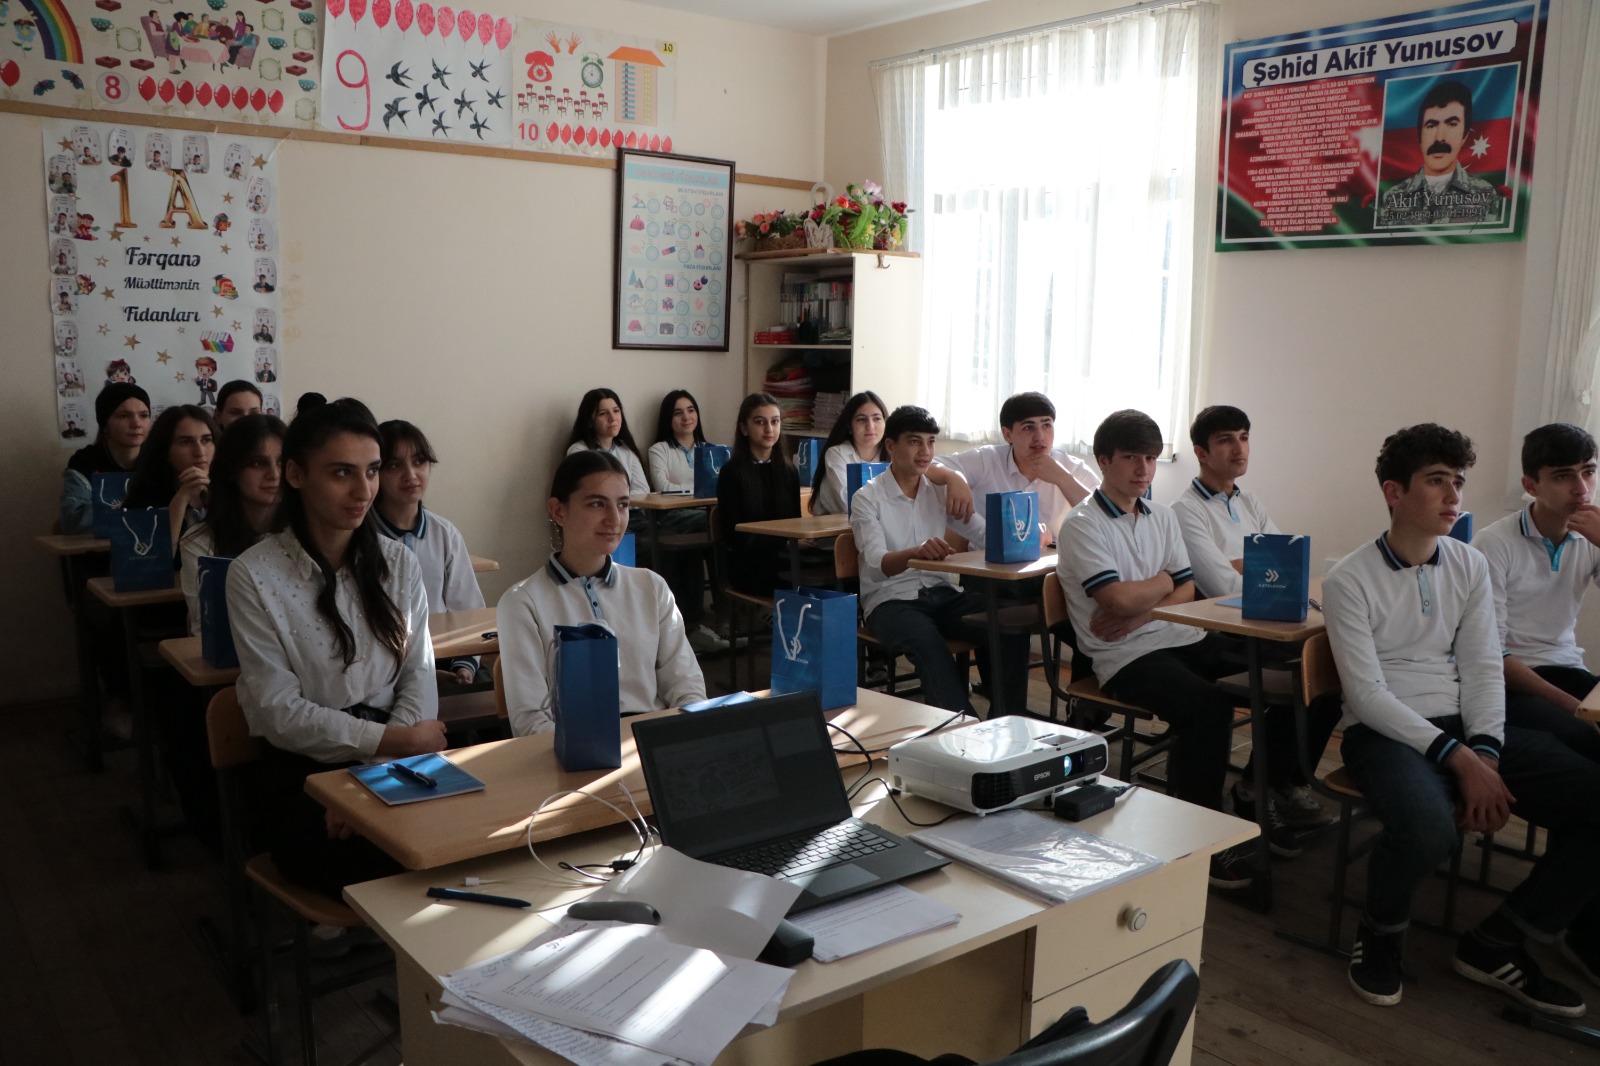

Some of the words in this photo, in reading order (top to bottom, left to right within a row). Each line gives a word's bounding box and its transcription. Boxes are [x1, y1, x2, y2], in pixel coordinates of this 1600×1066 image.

[663, 43, 673, 52] 10
[1253, 54, 1318, 86] Şəhid
[1324, 43, 1377, 73] Akif
[1384, 30, 1504, 64] Yunusov
[105, 75, 122, 99] 8
[335, 50, 371, 130] 9
[518, 122, 539, 141] 10
[110, 168, 138, 228] 1
[159, 168, 209, 229] A
[1387, 191, 1420, 208] Akif
[1423, 190, 1491, 206] Yunusov
[1034, 771, 1051, 781] EPSON
